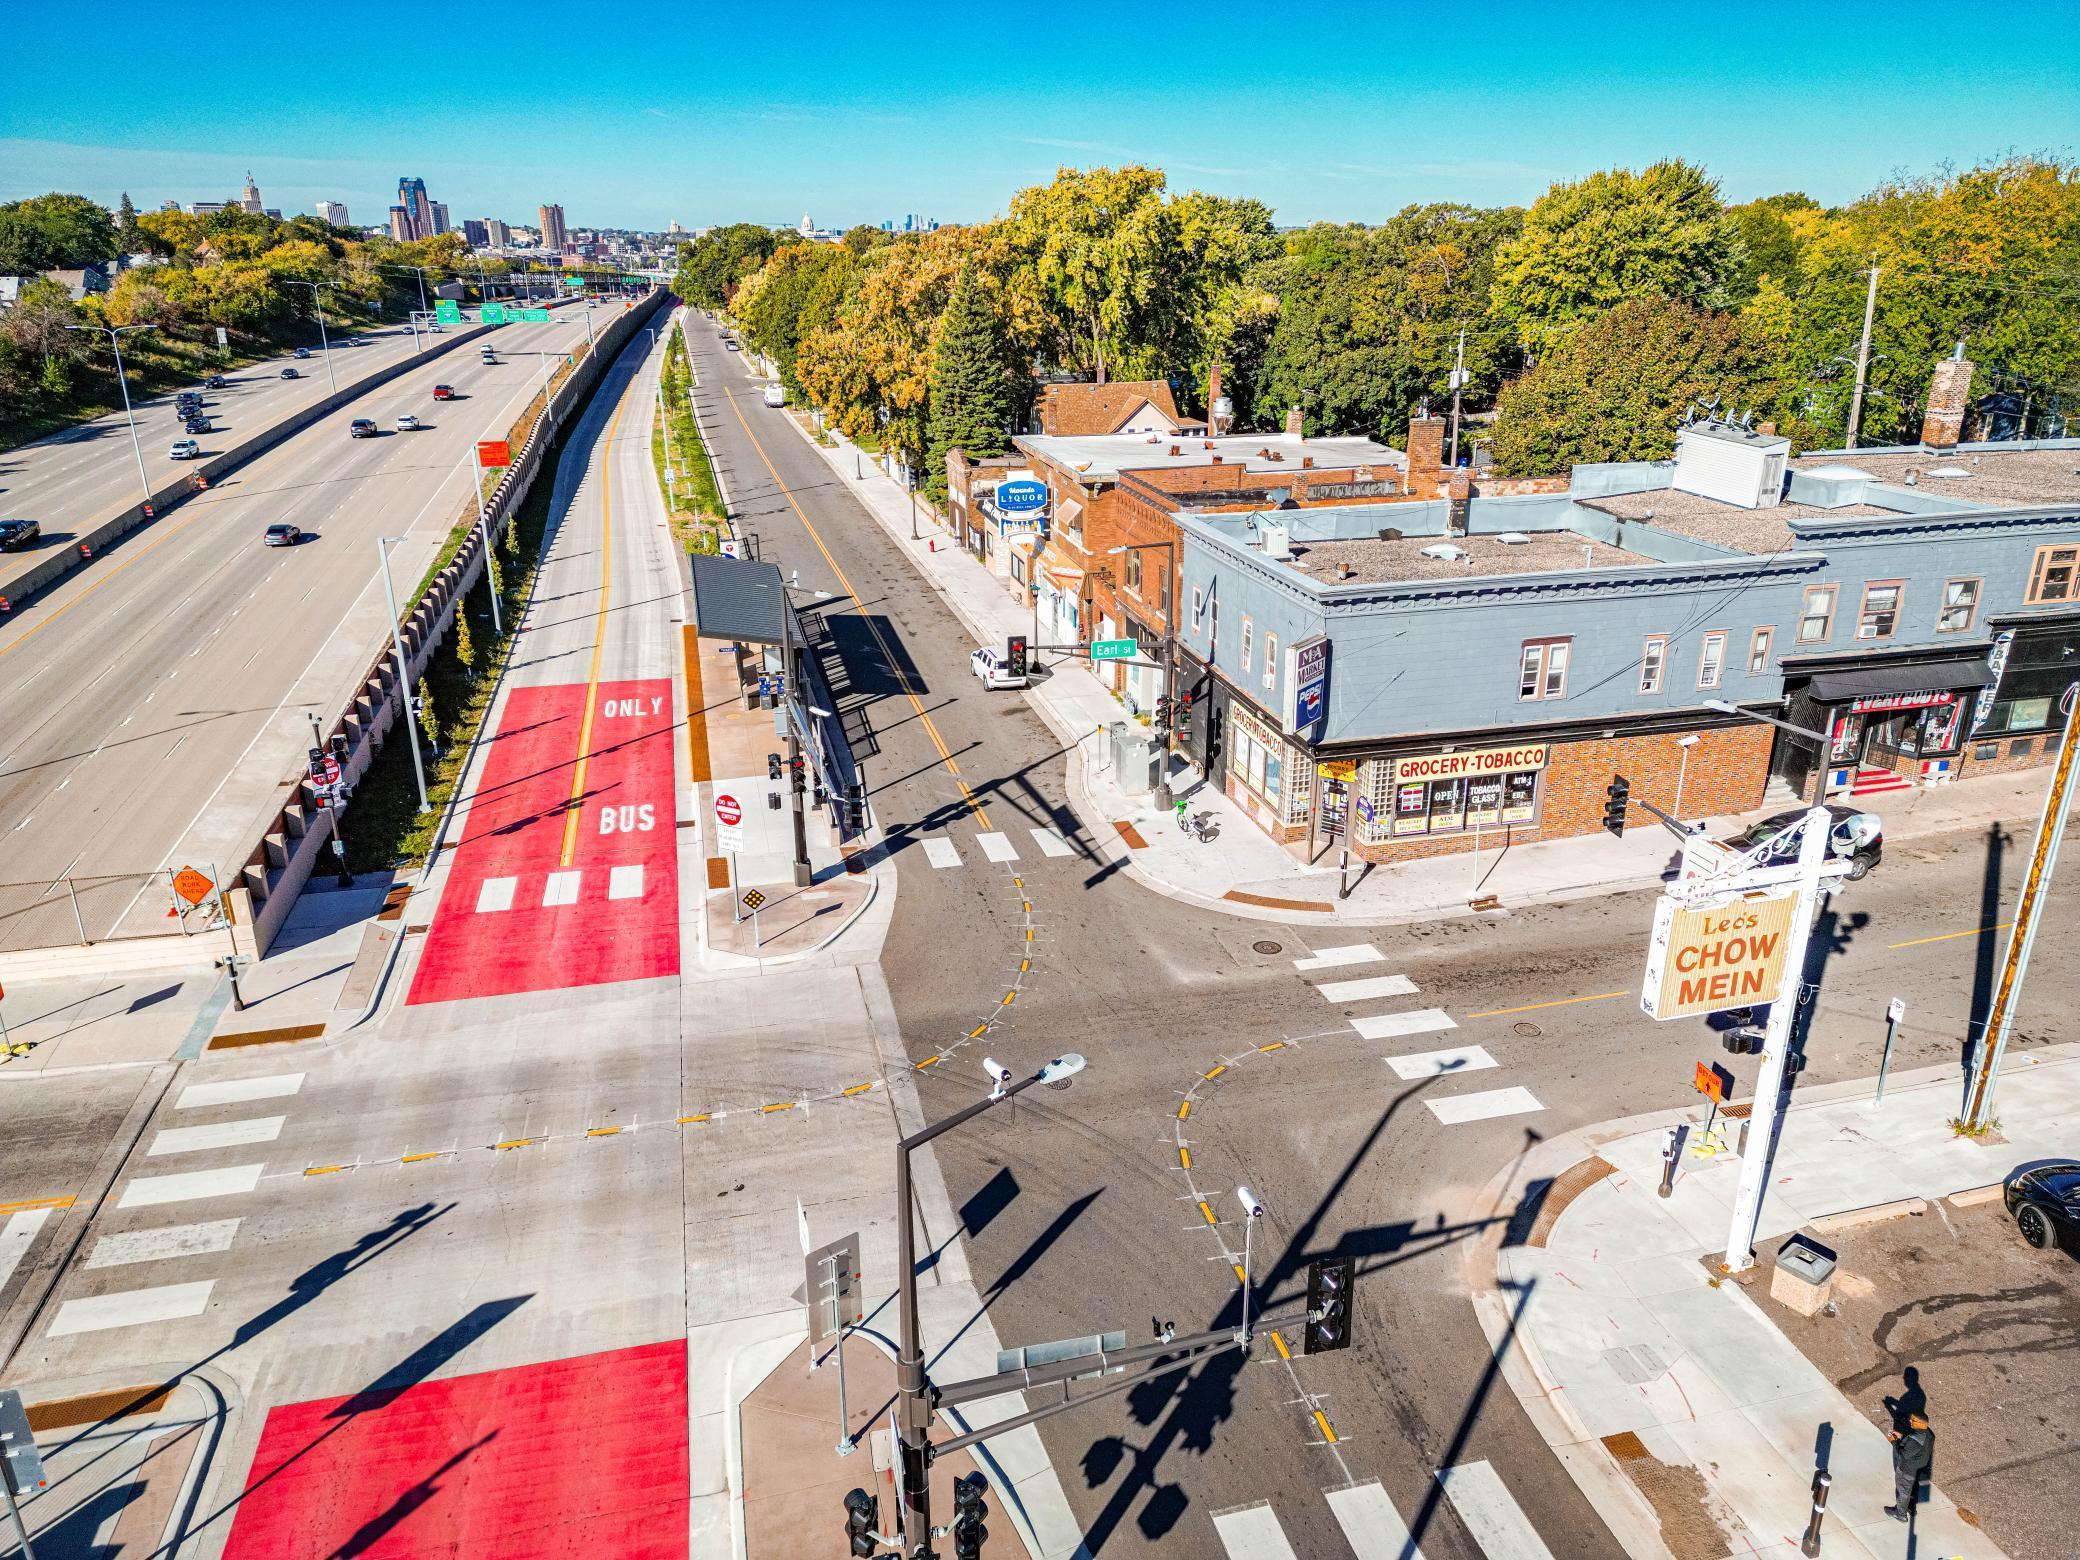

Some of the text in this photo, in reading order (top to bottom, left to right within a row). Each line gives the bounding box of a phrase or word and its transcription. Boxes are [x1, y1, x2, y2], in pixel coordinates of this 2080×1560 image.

[1001, 494, 1043, 502] LIQUOR
[1097, 645, 1118, 656] Earl
[1298, 659, 1325, 686] MARKET
[1299, 684, 1322, 705] PEPSI
[605, 697, 662, 717] ONLY
[1514, 777, 1526, 785] ATM
[1470, 784, 1501, 795] TOBACCO
[1435, 790, 1459, 801] OPEN
[1472, 794, 1496, 804] GLASS
[599, 805, 655, 834] BUS
[721, 813, 737, 821] ENTER
[1676, 933, 1779, 973] CHOW
[1678, 968, 1764, 1005] MEIN
